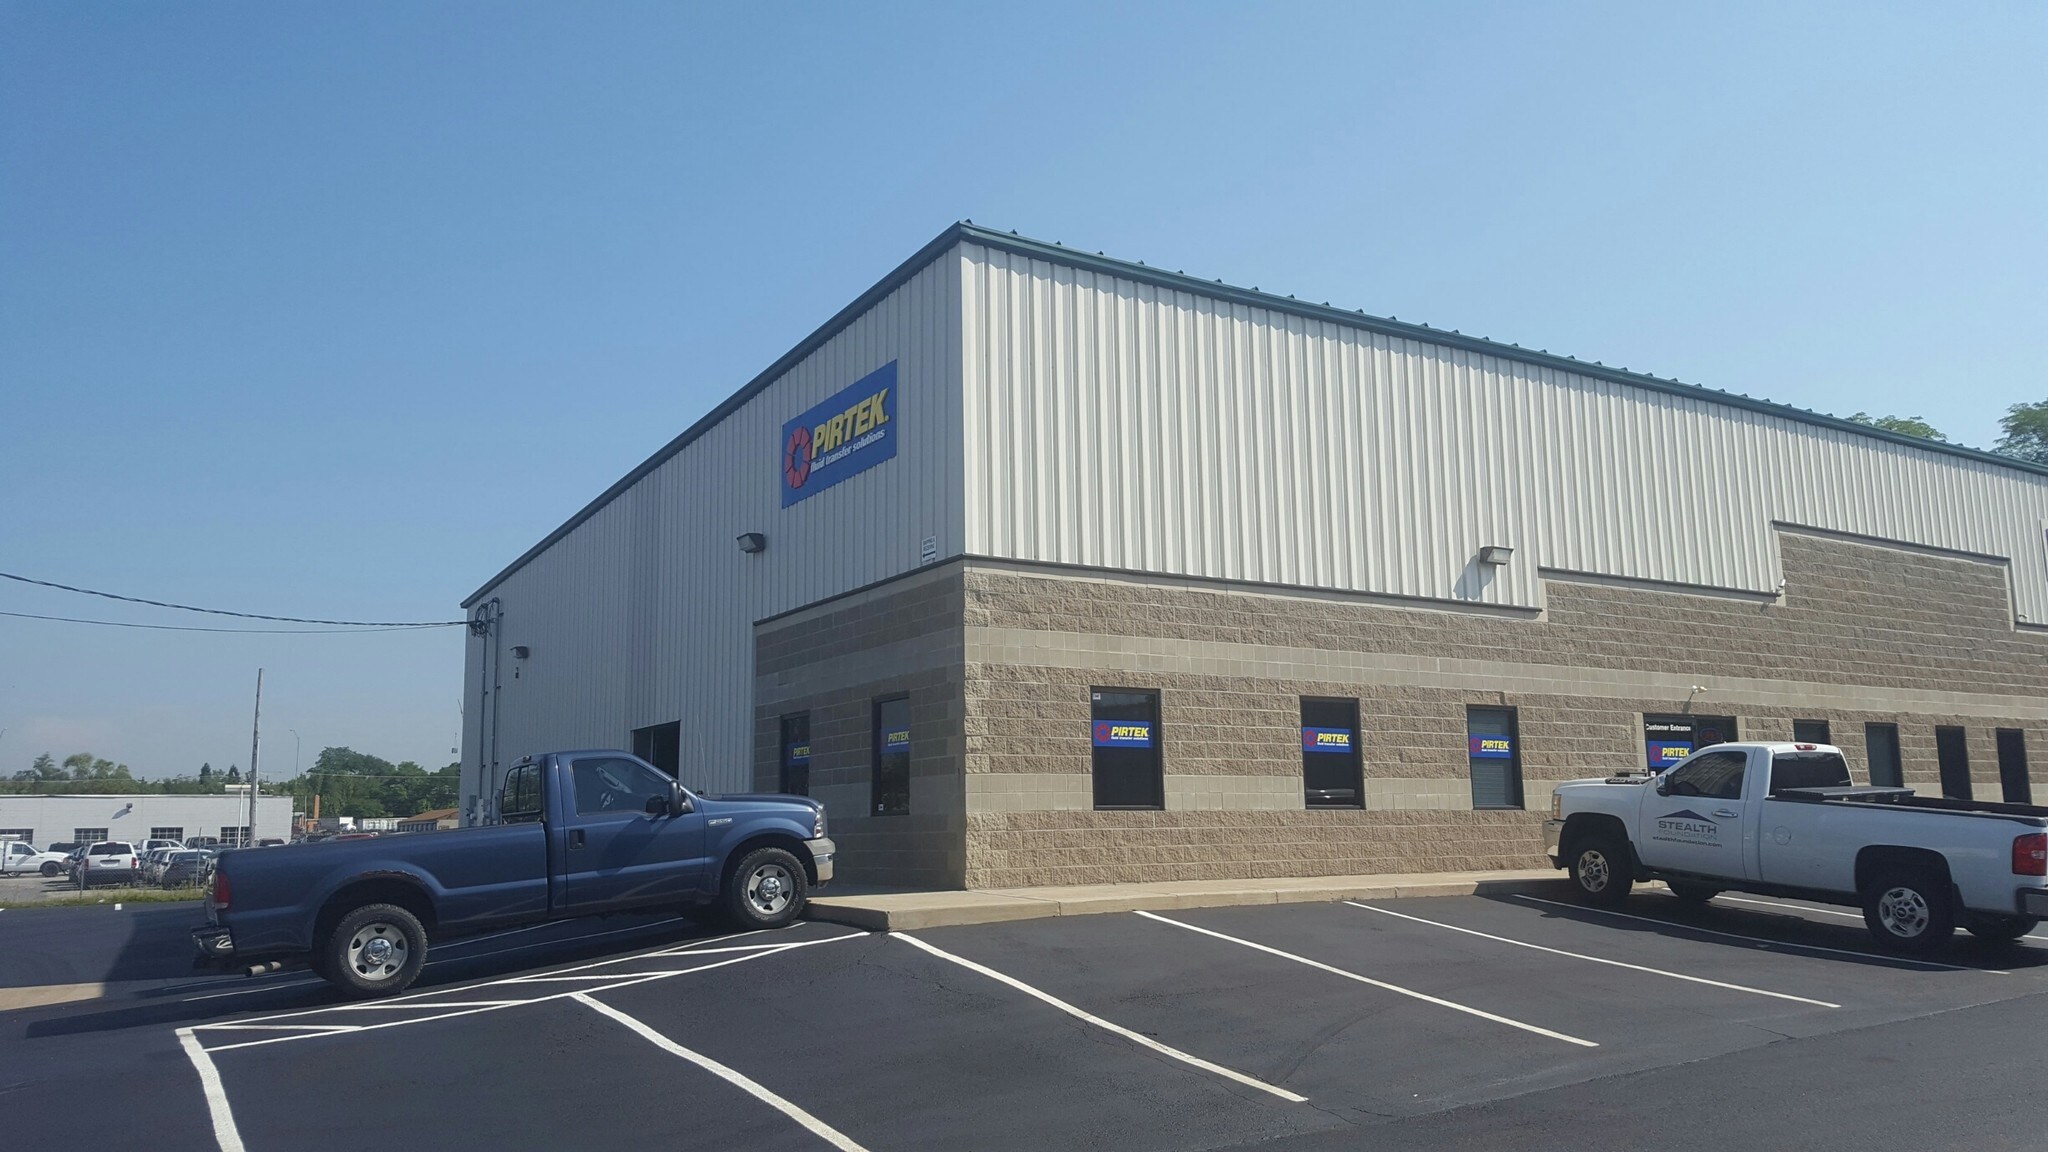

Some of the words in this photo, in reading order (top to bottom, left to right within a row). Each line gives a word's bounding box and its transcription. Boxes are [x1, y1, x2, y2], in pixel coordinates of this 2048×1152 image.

[811, 387, 889, 460] PIRTEK
[825, 444, 853, 466] transfer
[852, 429, 886, 452] solutions
[887, 731, 910, 743] PIRTEK
[1111, 726, 1149, 737] PIRTEK
[1317, 733, 1350, 743] PIRTEK
[1481, 739, 1510, 750] PIRTEK
[793, 746, 810, 757] PIRTEK
[1662, 747, 1690, 757] PIRTEK
[1658, 820, 1717, 834] STEALTH
